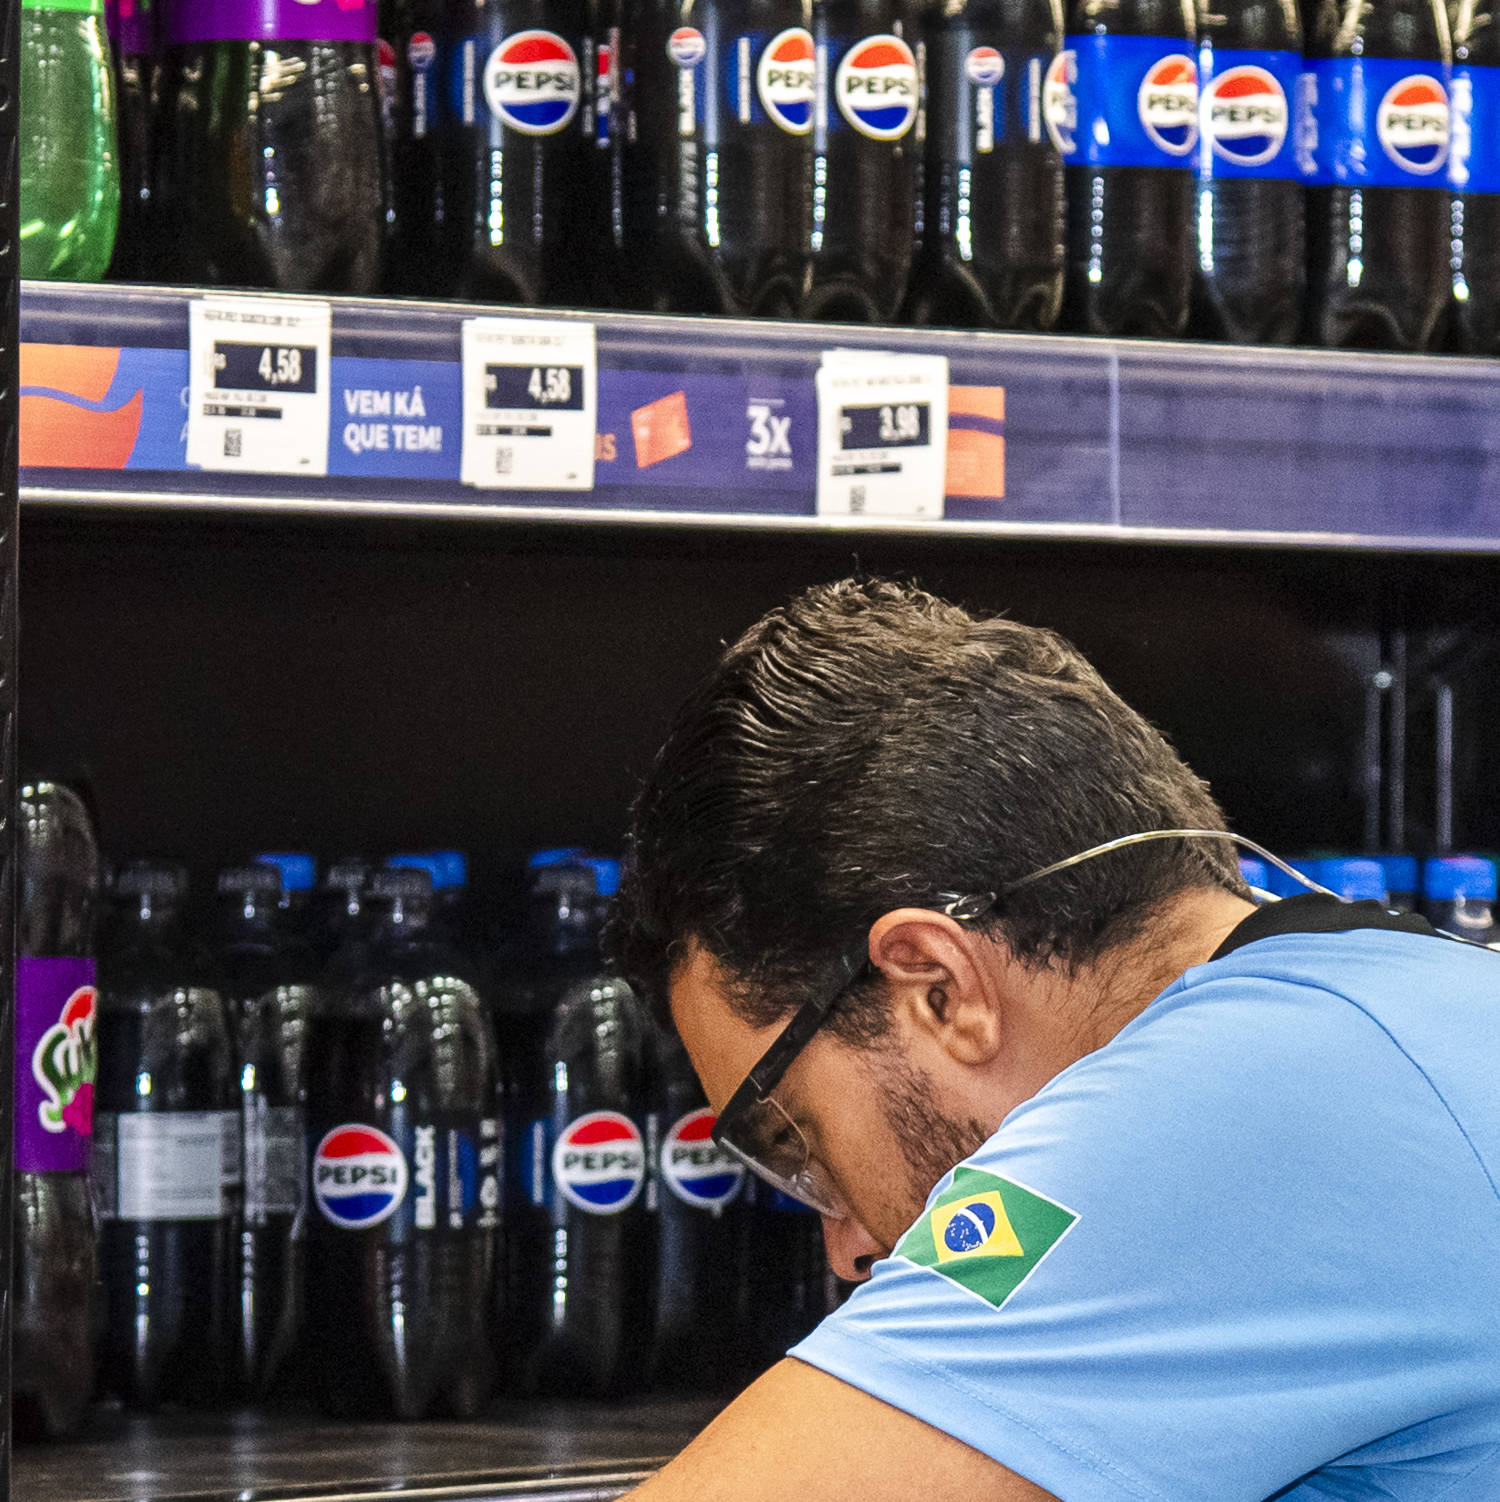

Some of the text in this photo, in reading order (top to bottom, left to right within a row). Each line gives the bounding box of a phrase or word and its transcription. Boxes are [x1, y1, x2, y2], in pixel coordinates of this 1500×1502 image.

[258, 346, 303, 386] 4,58
[344, 385, 426, 419] VEM KÁ
[343, 423, 443, 453] QUE TEM!
[319, 1165, 398, 1185] PEPSI
